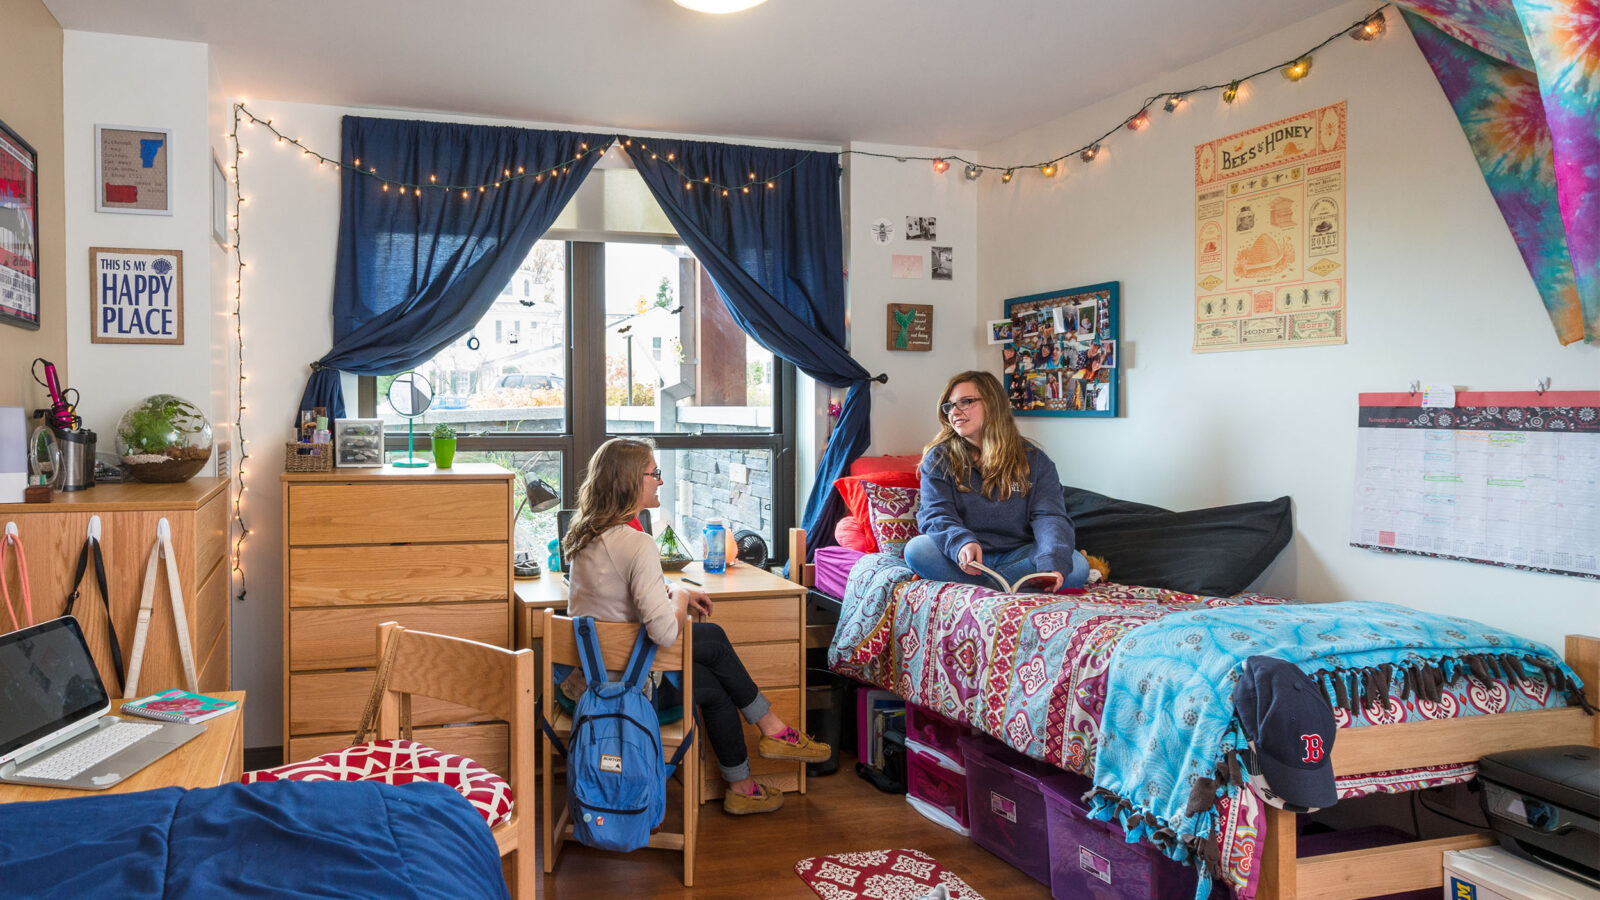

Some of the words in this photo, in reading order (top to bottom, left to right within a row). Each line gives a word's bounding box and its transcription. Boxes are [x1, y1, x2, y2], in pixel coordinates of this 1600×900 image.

[1221, 146, 1257, 170] BEES
[1257, 141, 1264, 153] &
[1265, 126, 1313, 155] HONEY
[1311, 235, 1337, 247] HONEY
[100, 258, 121, 271] THIS
[123, 260, 131, 271] IS
[133, 261, 147, 272] MY
[102, 272, 173, 307] HAPPY
[102, 306, 173, 335] PLACE
[1243, 327, 1283, 336] HONEY
[1300, 734, 1325, 763] B
